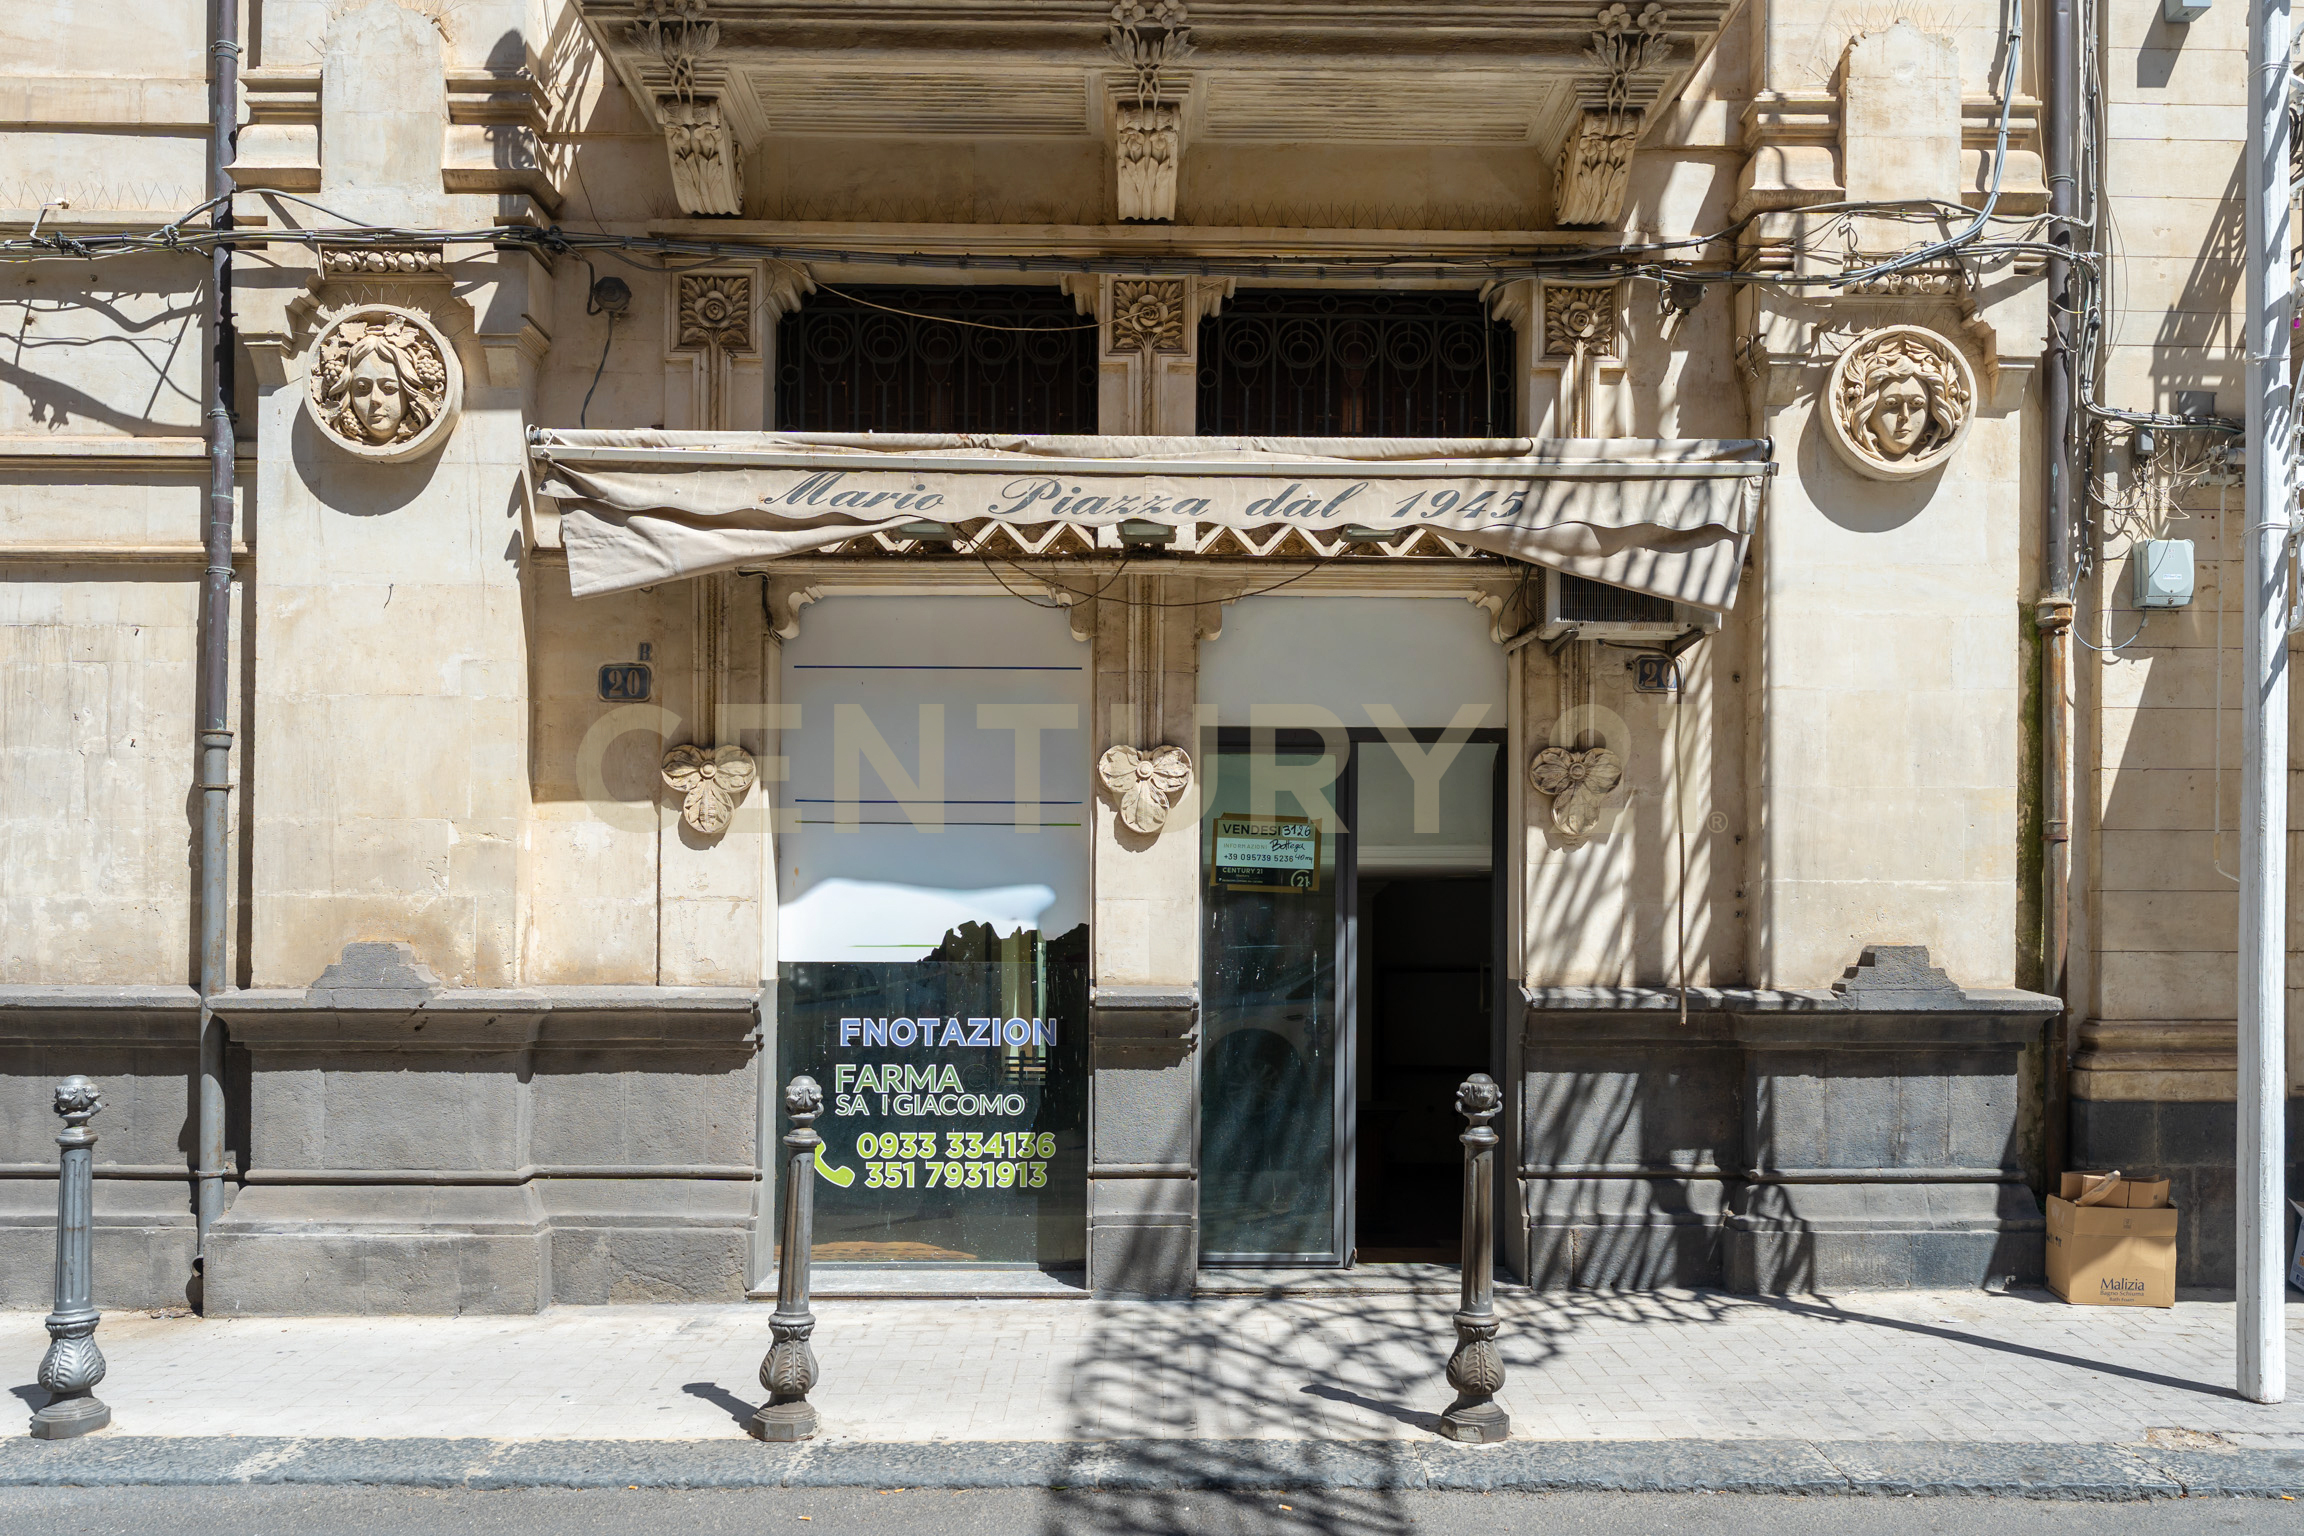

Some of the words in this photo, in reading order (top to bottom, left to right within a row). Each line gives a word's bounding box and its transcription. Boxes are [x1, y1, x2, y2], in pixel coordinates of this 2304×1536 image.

[764, 470, 945, 512] Mario
[987, 475, 1210, 517] Piazza
[1245, 481, 1369, 520] dal
[1390, 488, 1531, 520] 1945
[608, 668, 641, 697] 20
[1223, 823, 1281, 836] VENDESI
[893, 1094, 1025, 1116] GIACOMO
[856, 1131, 937, 1159] 0933
[945, 1131, 1056, 1159] 334136
[865, 1161, 915, 1188] 351
[925, 1161, 1048, 1188] 7931913
[2101, 1277, 2145, 1291] Malizia
